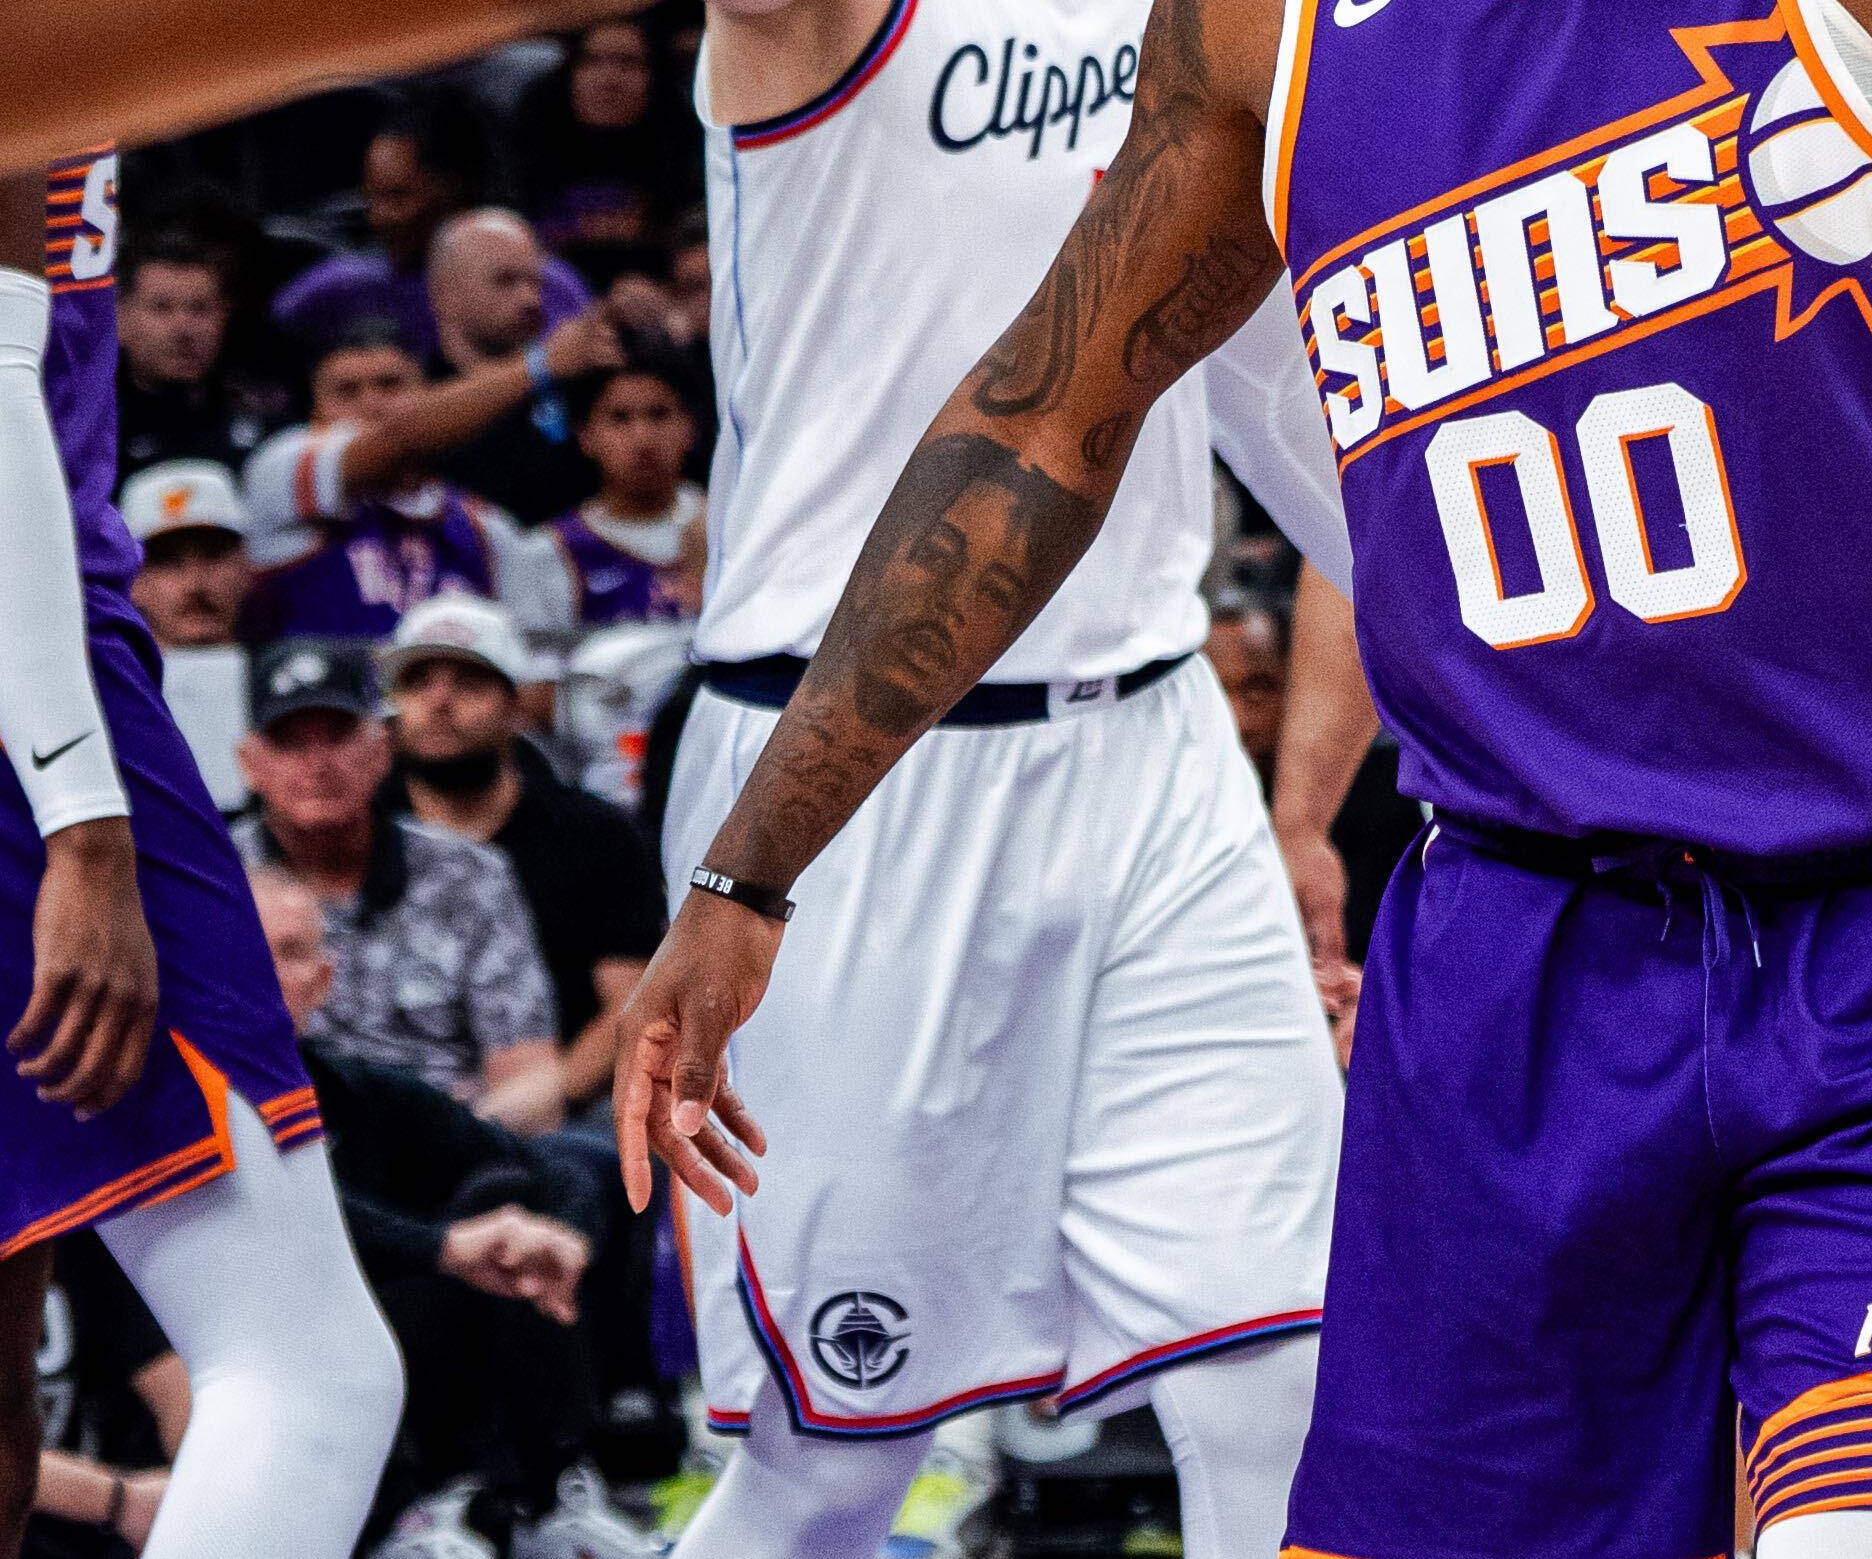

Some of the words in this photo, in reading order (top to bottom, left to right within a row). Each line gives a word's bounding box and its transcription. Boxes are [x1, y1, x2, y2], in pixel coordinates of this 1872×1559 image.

[928, 36, 1143, 160] Clippe
[1309, 123, 1732, 451] SUNS
[1424, 382, 1748, 651] 00
